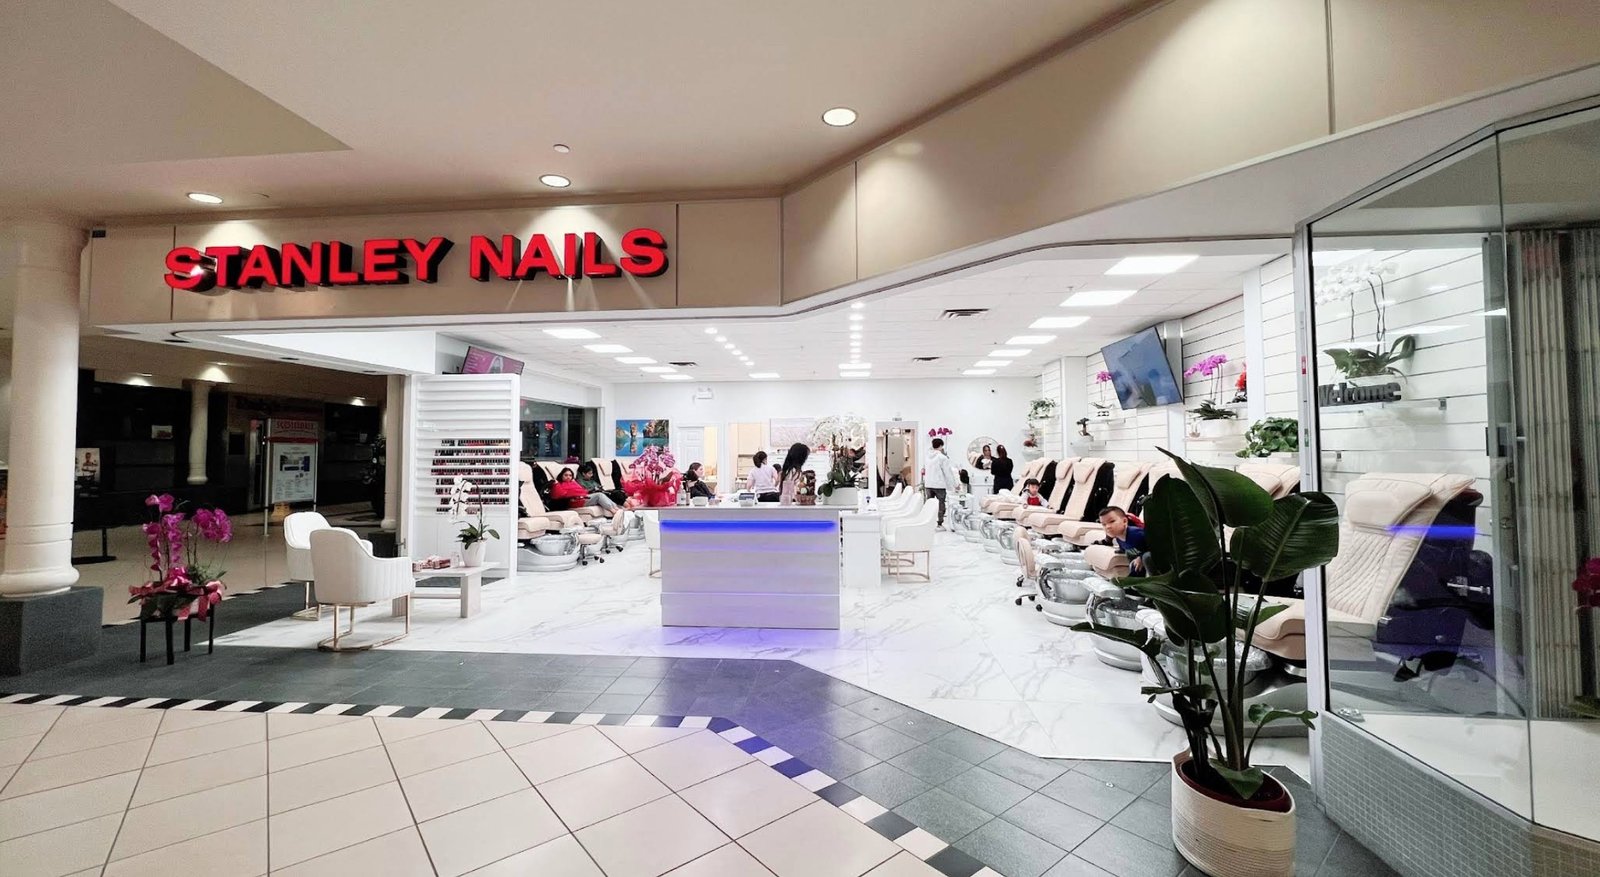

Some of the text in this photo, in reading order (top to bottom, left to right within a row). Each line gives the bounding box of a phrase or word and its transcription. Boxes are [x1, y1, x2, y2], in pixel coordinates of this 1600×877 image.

[164, 228, 668, 291] STANLEY NAILS
[1318, 382, 1401, 407] Welcome
